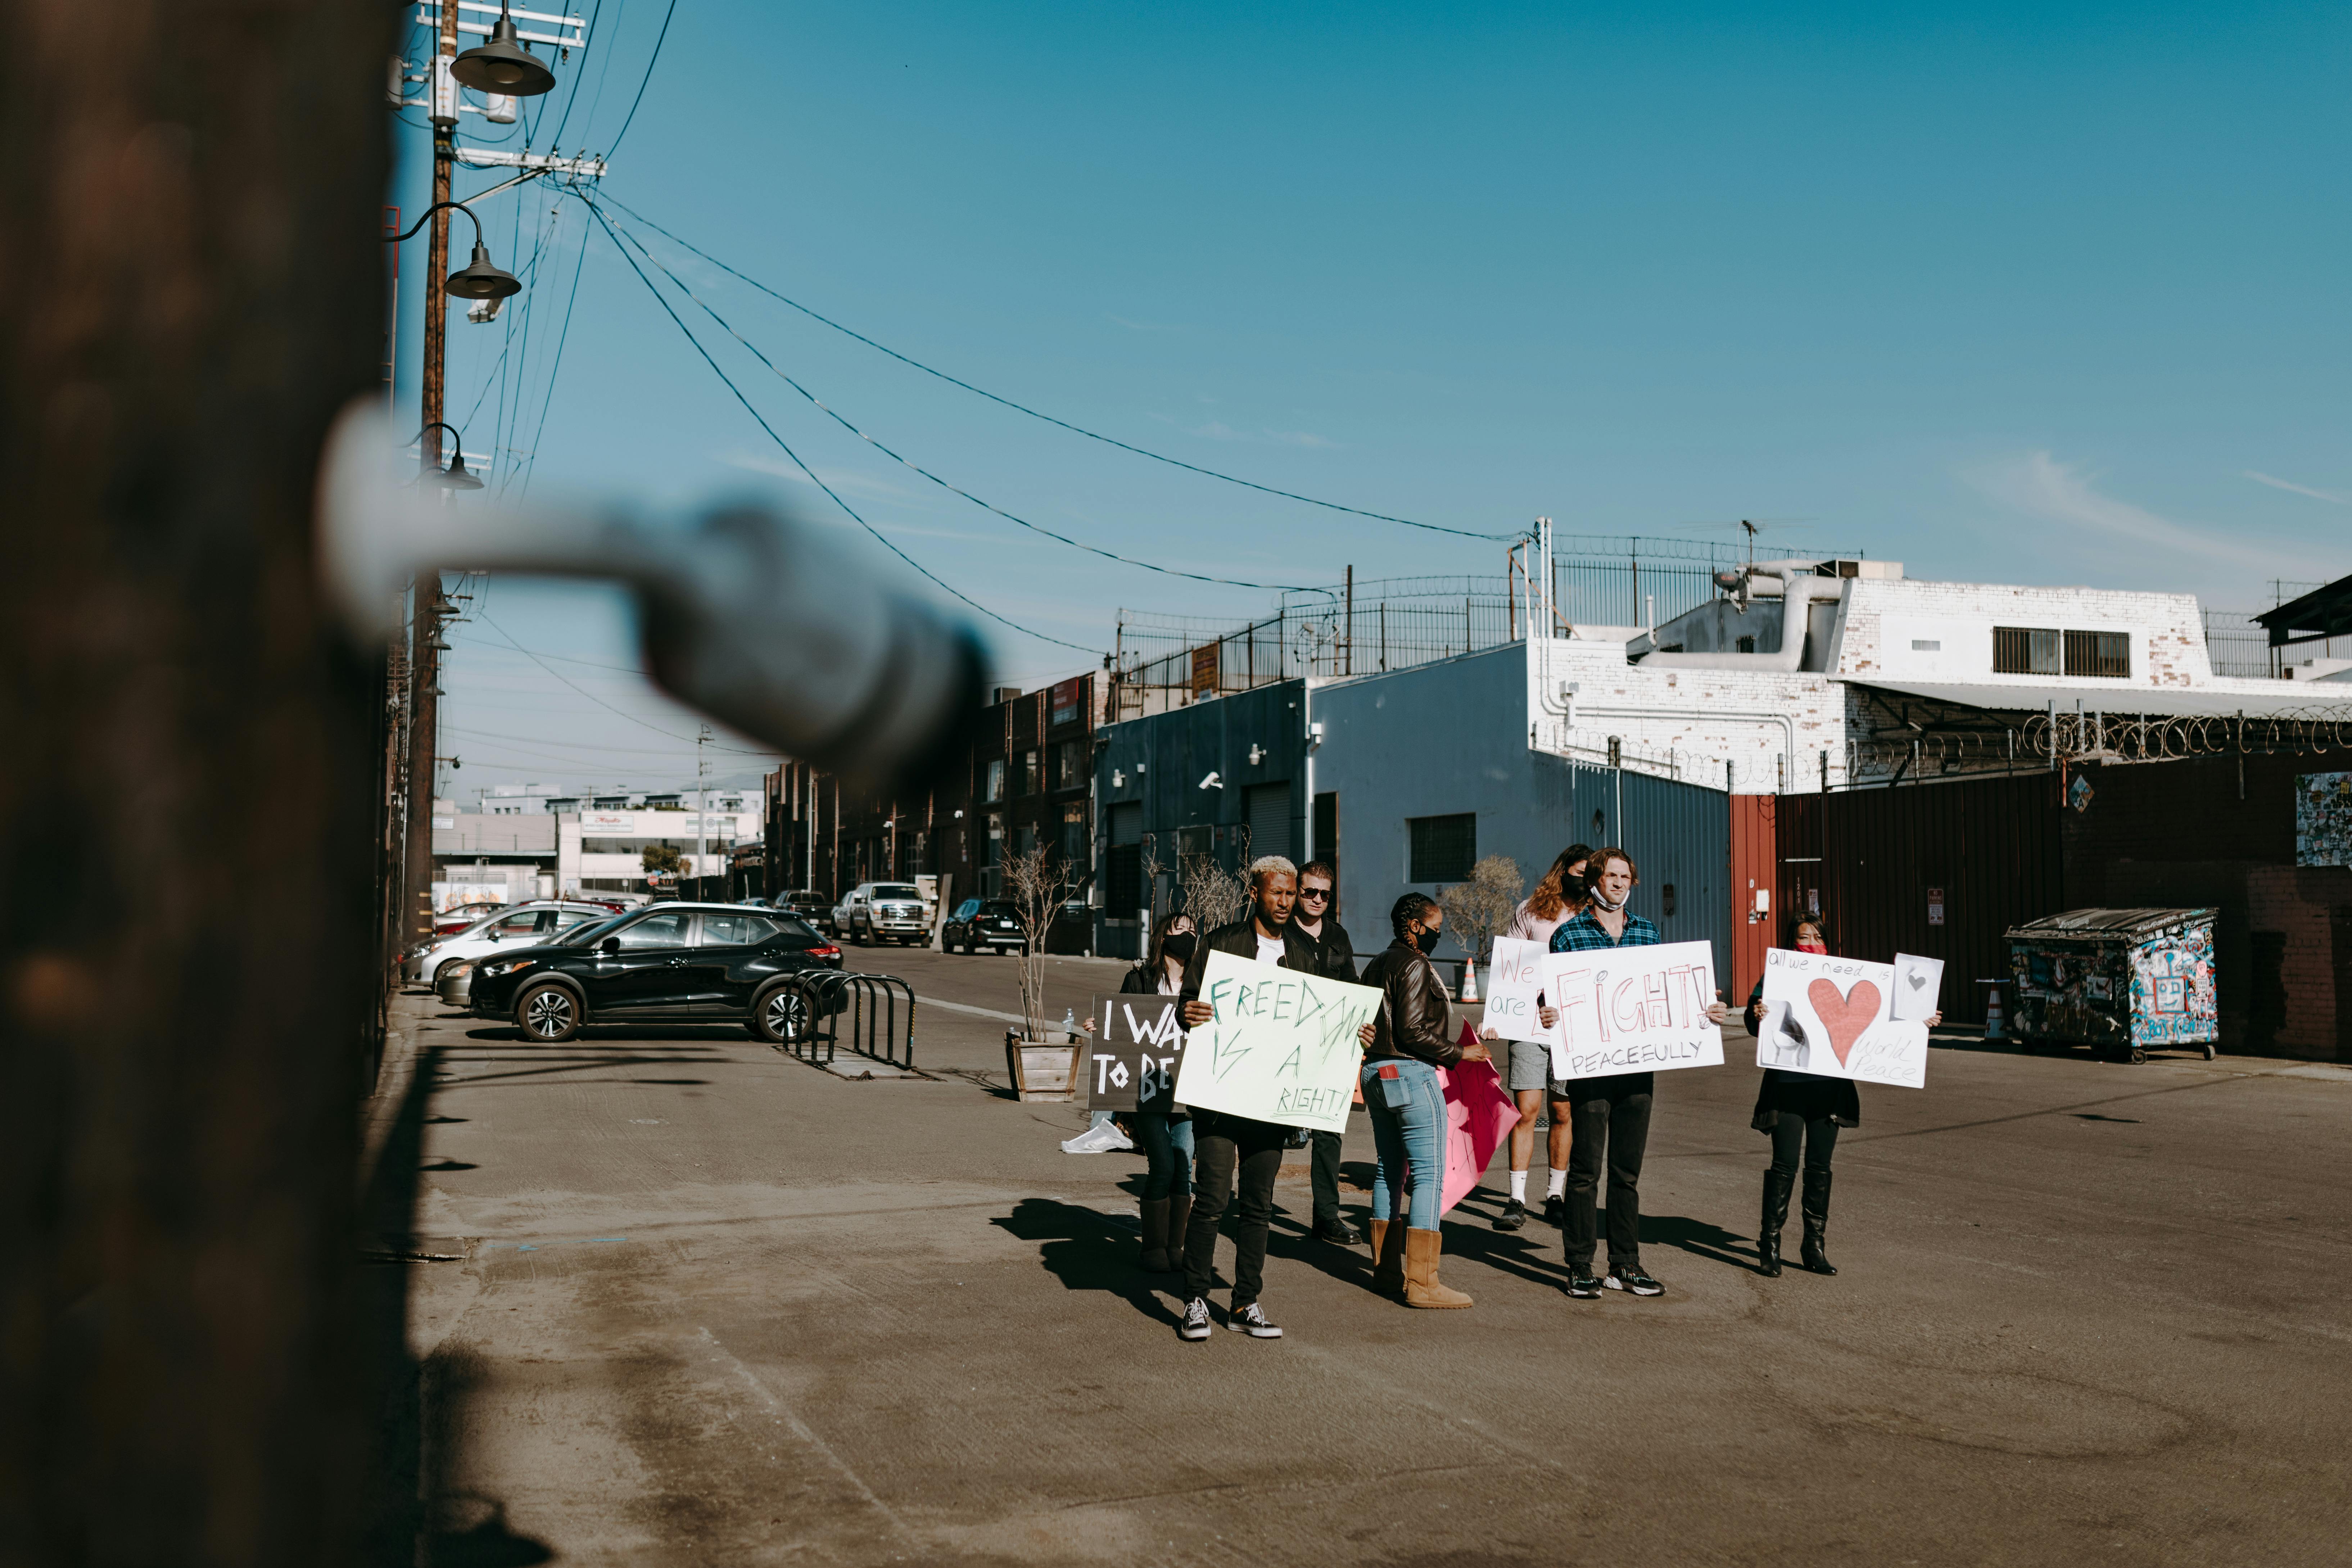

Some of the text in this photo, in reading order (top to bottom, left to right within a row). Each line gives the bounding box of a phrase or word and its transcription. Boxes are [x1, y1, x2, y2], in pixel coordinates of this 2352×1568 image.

[2078, 798, 2084, 808] A
[1501, 946, 1534, 983] We
[1769, 951, 1890, 980] all we need is
[1211, 977, 1368, 1065] FREEDOM
[1491, 996, 1525, 1016] are
[1104, 1000, 1189, 1051] I WA
[1212, 1028, 1301, 1084] IS A
[1853, 1035, 1912, 1062] World
[1140, 1053, 1175, 1103] BE
[1852, 1054, 1919, 1082] Peace
[1277, 1087, 1350, 1117] RIGHT!
